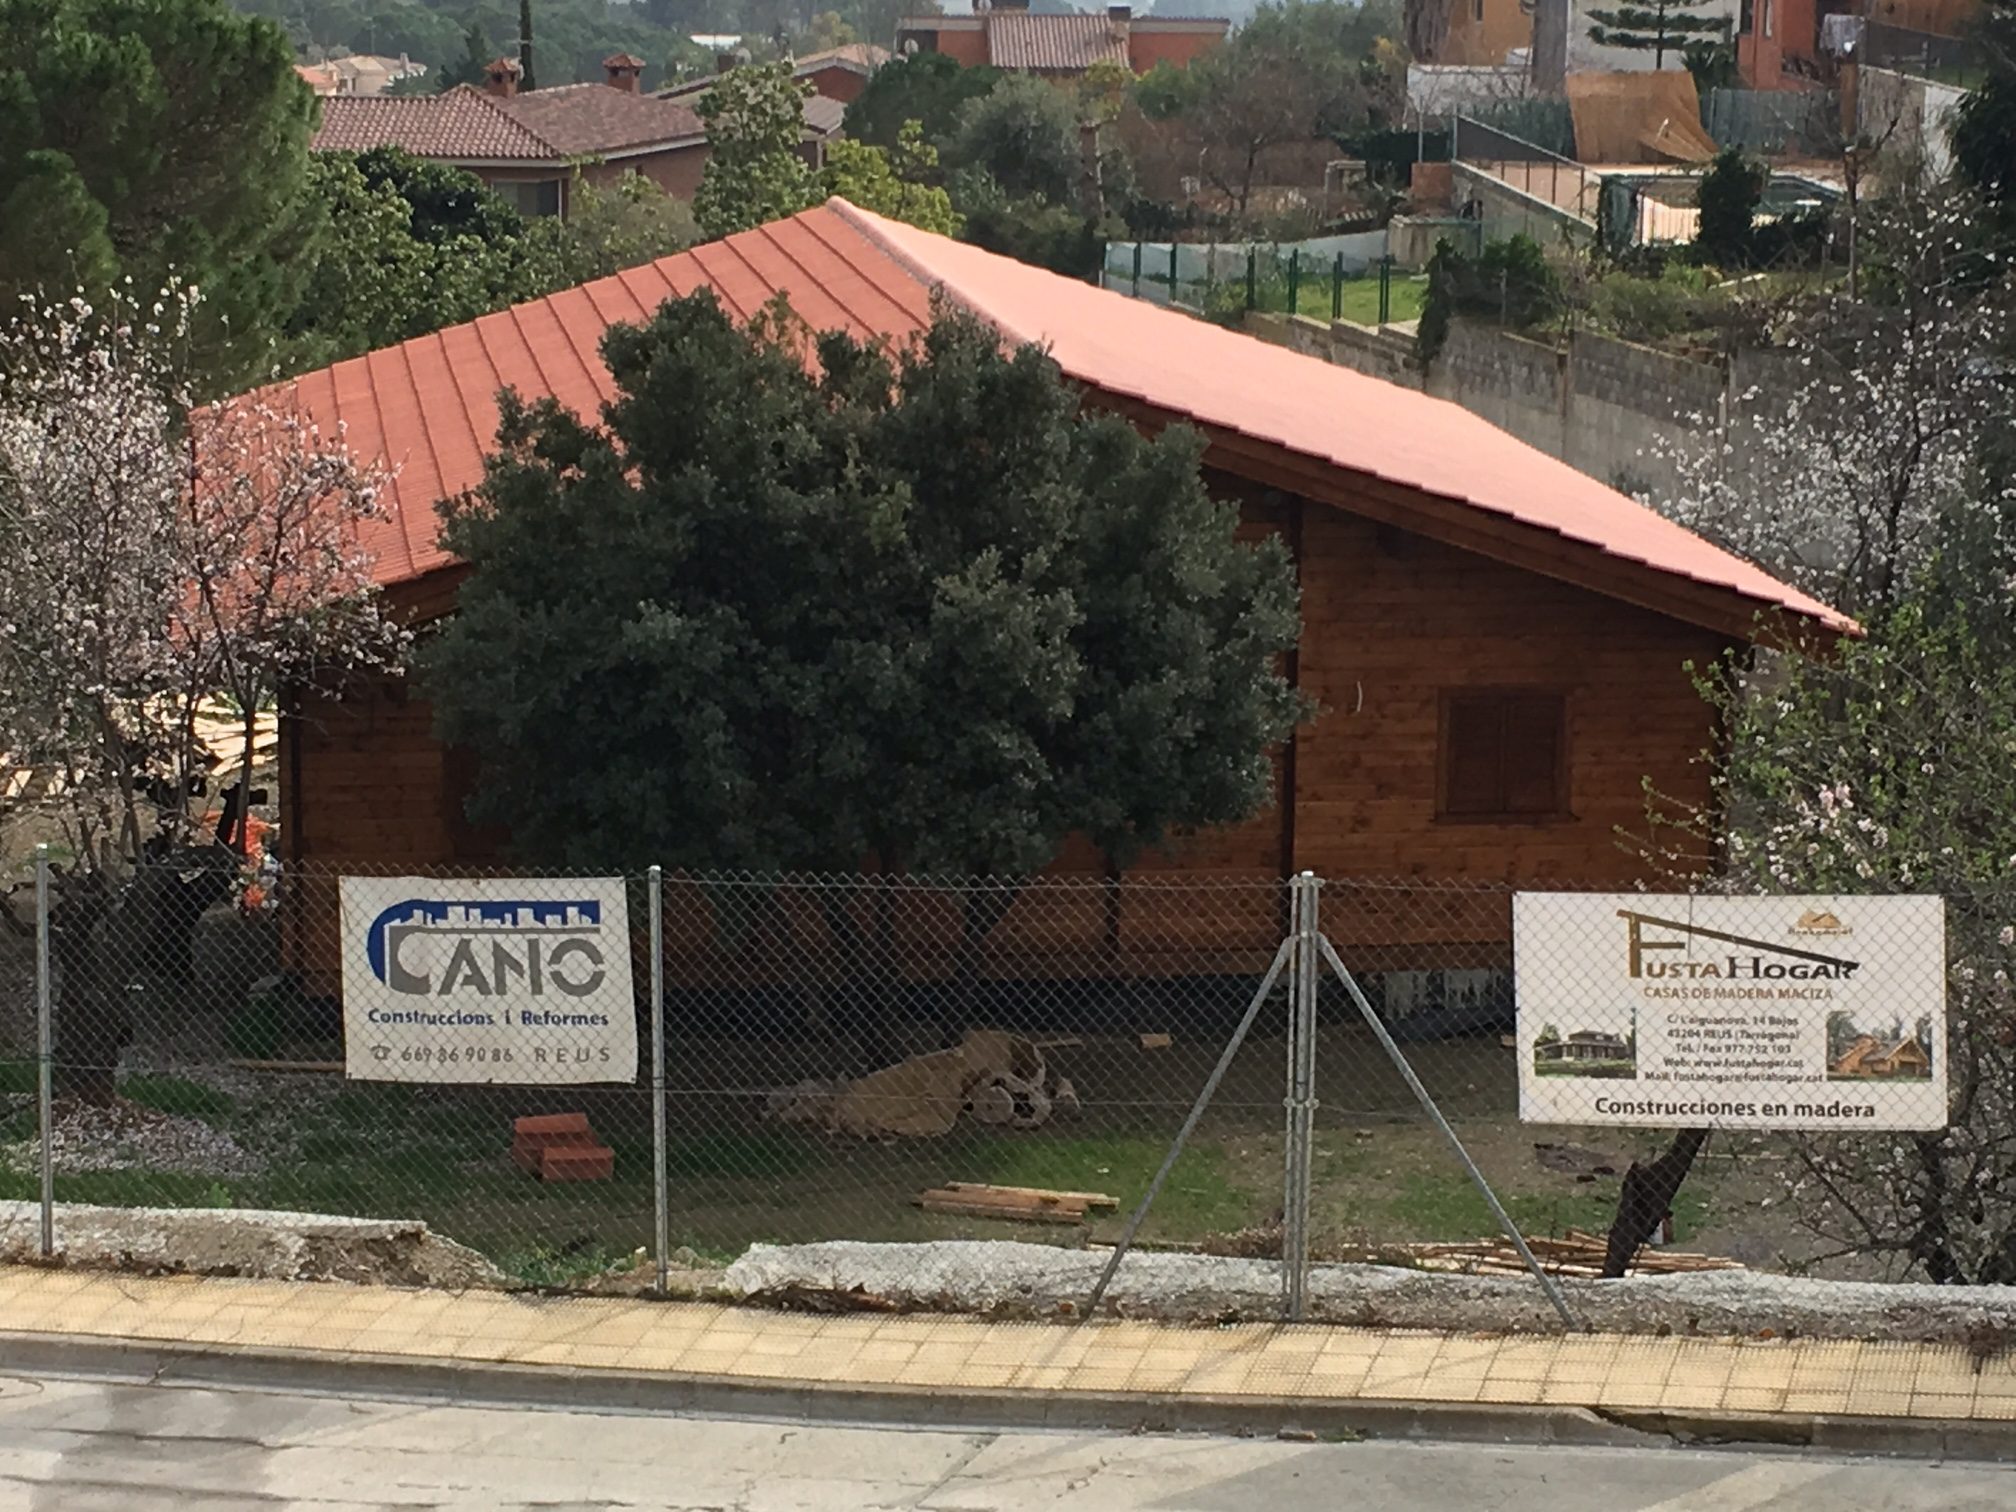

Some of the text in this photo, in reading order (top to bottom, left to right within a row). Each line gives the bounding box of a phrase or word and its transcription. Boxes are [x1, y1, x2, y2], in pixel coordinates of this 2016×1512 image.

[386, 924, 606, 998] CANO
[1643, 986, 1689, 999] CASAS
[1714, 987, 1775, 1000] MADERA
[1778, 988, 1834, 1001] MACIZA
[368, 1008, 494, 1025] Construccions
[521, 1010, 609, 1026] Reformes
[1703, 1029, 1732, 1039] REUS
[400, 1046, 433, 1062] 669
[465, 1046, 486, 1062] 90
[491, 1047, 514, 1063] 86
[534, 1046, 611, 1063] REUS
[1594, 1097, 1876, 1118] Construcciones en madera
